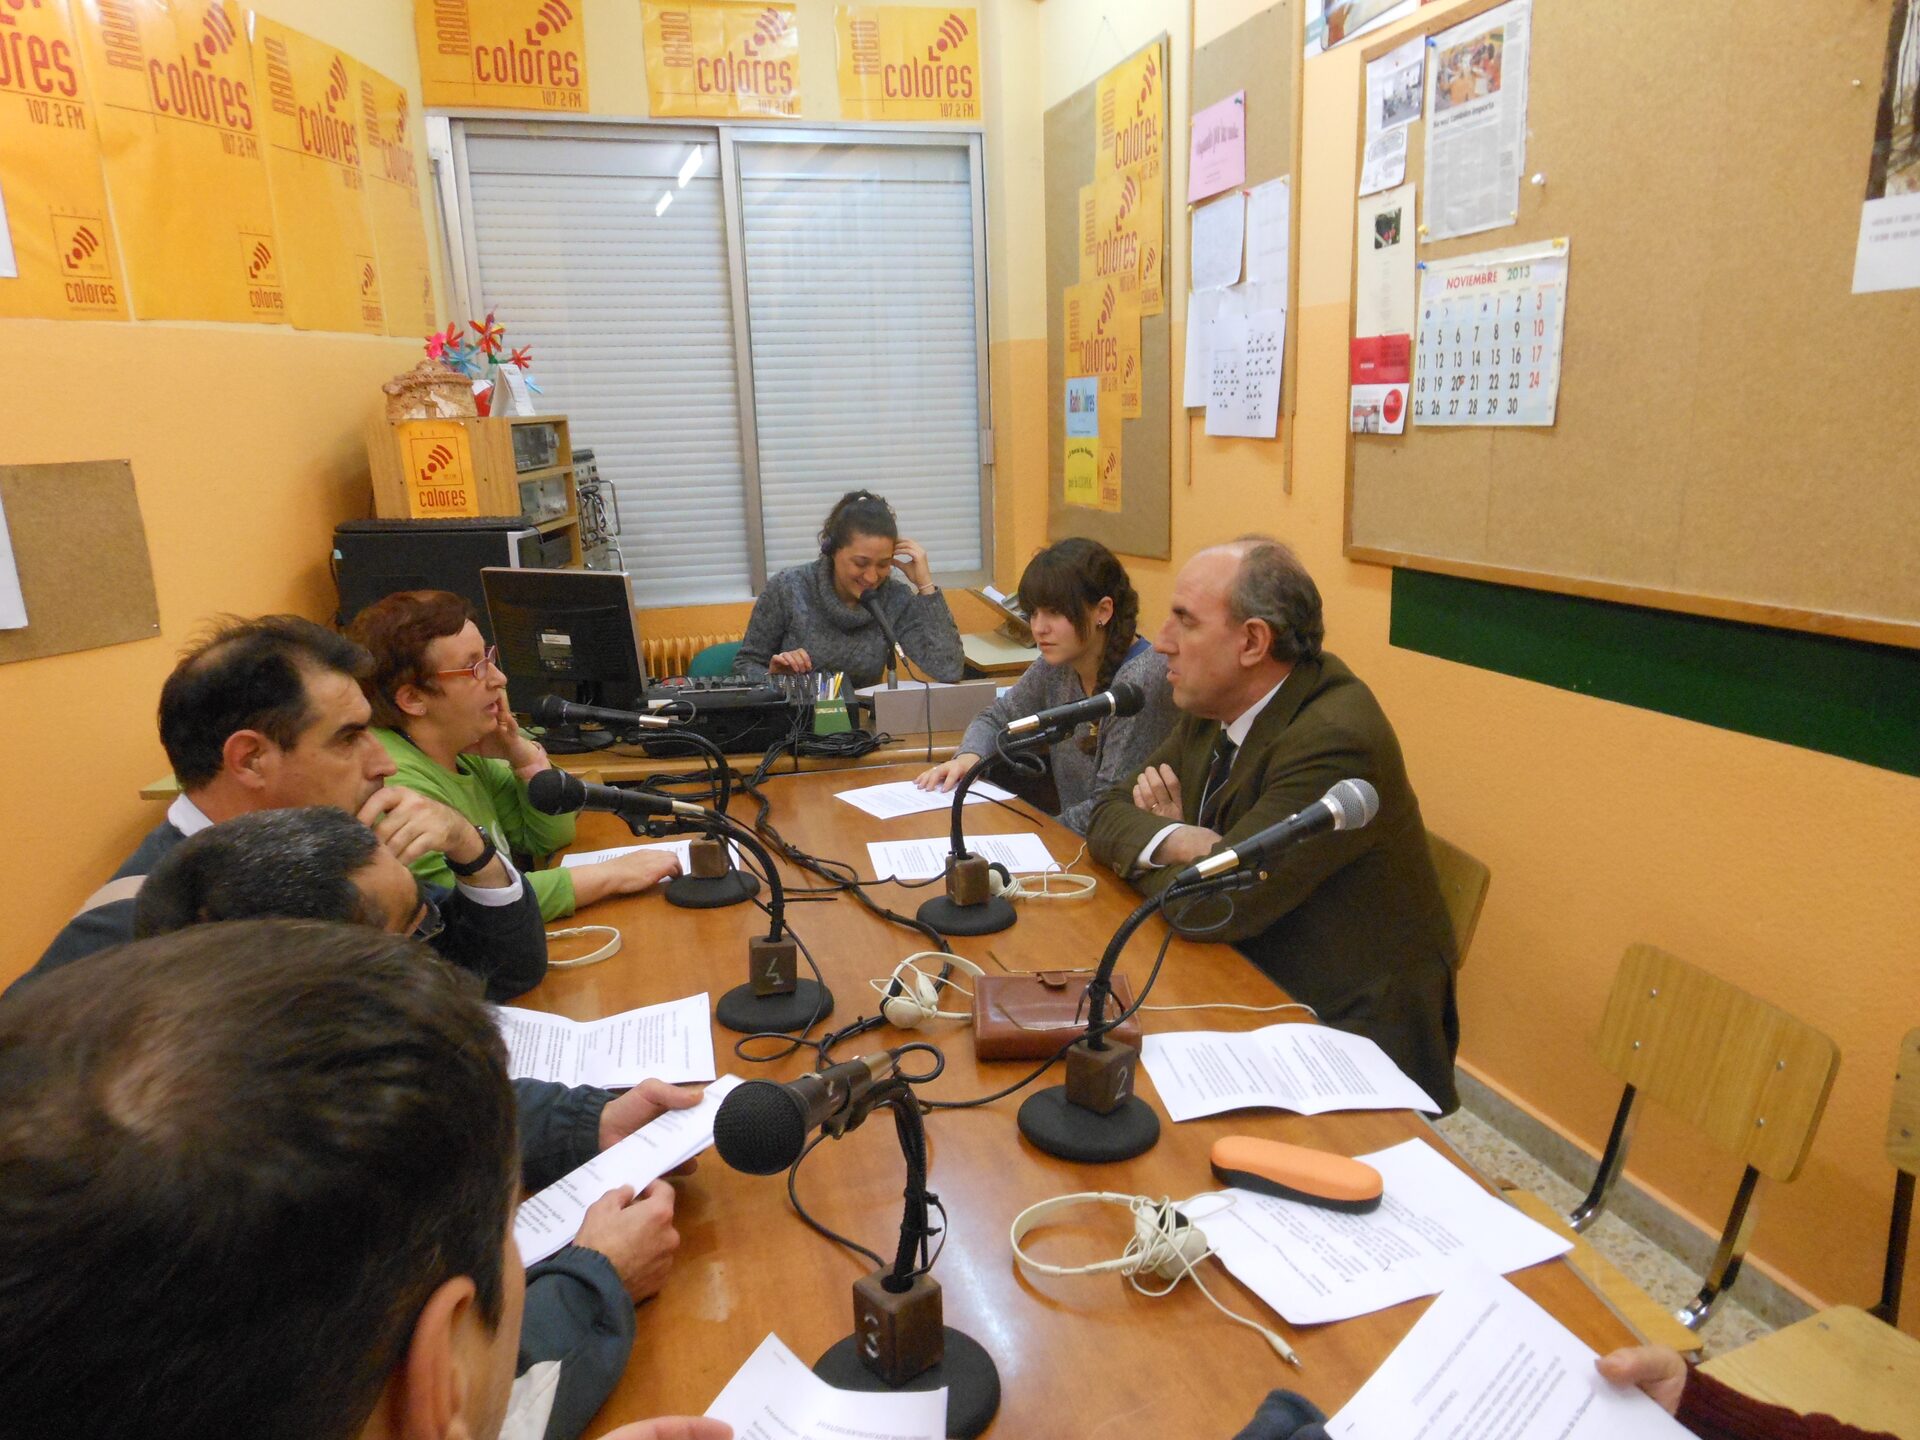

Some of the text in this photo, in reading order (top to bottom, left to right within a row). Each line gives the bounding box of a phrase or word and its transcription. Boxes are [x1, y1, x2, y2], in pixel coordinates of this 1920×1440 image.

[96, 0, 143, 72] RADI
[659, 11, 693, 68] RADIO
[850, 21, 880, 75] RADIO
[475, 39, 579, 87] colores
[697, 51, 793, 95] colores
[885, 57, 973, 98] colores
[149, 55, 253, 131] colores
[963, 103, 974, 117] FM
[26, 98, 85, 130] 107.2 FM
[299, 102, 361, 167] colores
[1115, 114, 1158, 170] colores
[1096, 229, 1137, 277] colores
[65, 280, 117, 305] colores
[1446, 266, 1530, 289] NOVIEMBRE 2013
[249, 288, 284, 310] colores
[1515, 295, 1521, 313] 2
[1536, 292, 1542, 311] 3
[1419, 319, 1544, 346] 4 5 6 7 8 9 10
[1080, 333, 1118, 373] colores
[1418, 354, 1426, 369] 11
[1435, 352, 1444, 369] 12
[1453, 351, 1462, 368] 13
[1472, 350, 1480, 367] 14
[1491, 348, 1500, 366] 15
[1511, 347, 1521, 365] 16
[1532, 345, 1542, 363] 17
[1417, 371, 1540, 393] 18 19 20 21 22 23 24
[1415, 398, 1518, 416] 25 26 27 28 29 30
[418, 488, 467, 508] colores
[766, 957, 784, 985] 4
[1115, 1066, 1128, 1100] 2
[864, 1313, 879, 1358] 3
